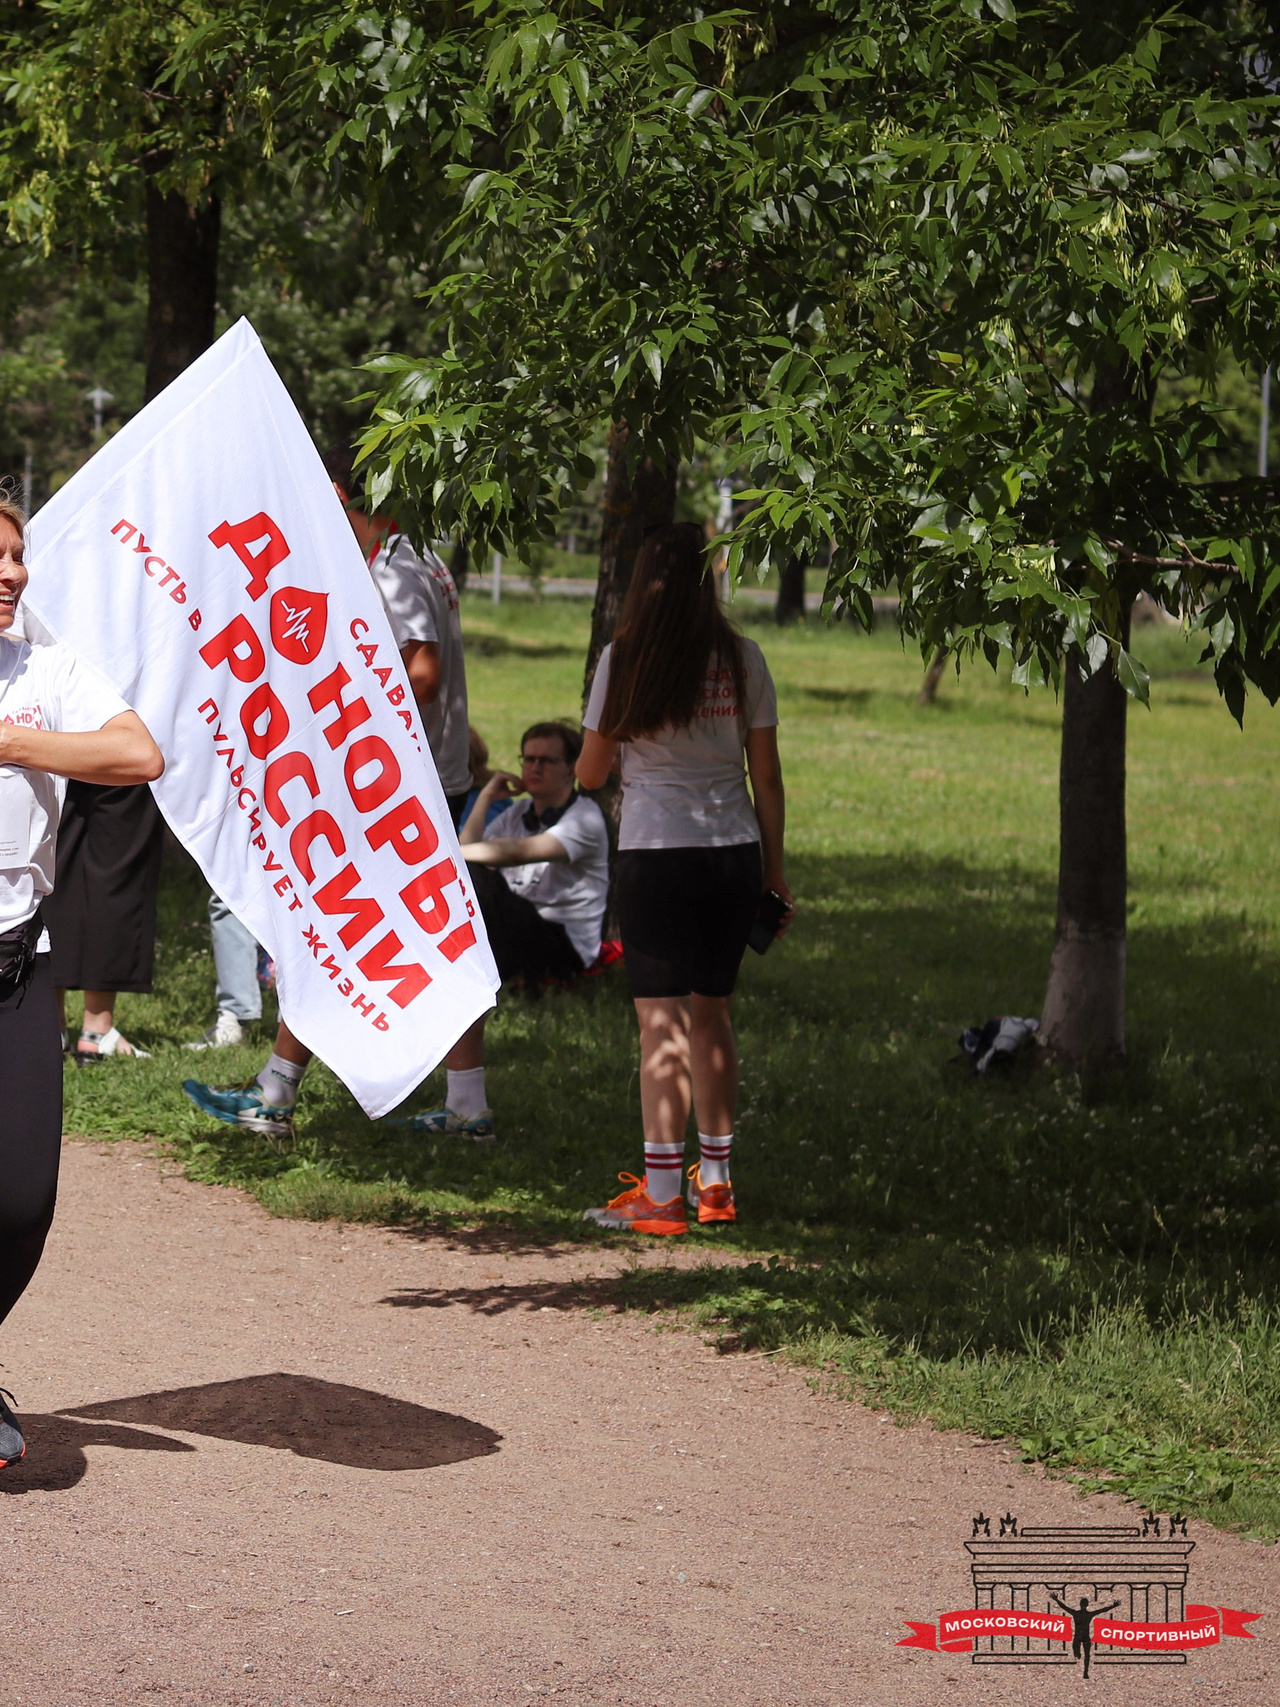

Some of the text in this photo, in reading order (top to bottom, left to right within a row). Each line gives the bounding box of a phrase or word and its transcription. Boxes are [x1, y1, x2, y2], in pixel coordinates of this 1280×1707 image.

[111, 519, 202, 631] ПУСТЬ В
[197, 697, 390, 1032] ПУЛЬСИРУЕТ ЖИЗНЬ
[199, 613, 434, 1009] РОССИИ
